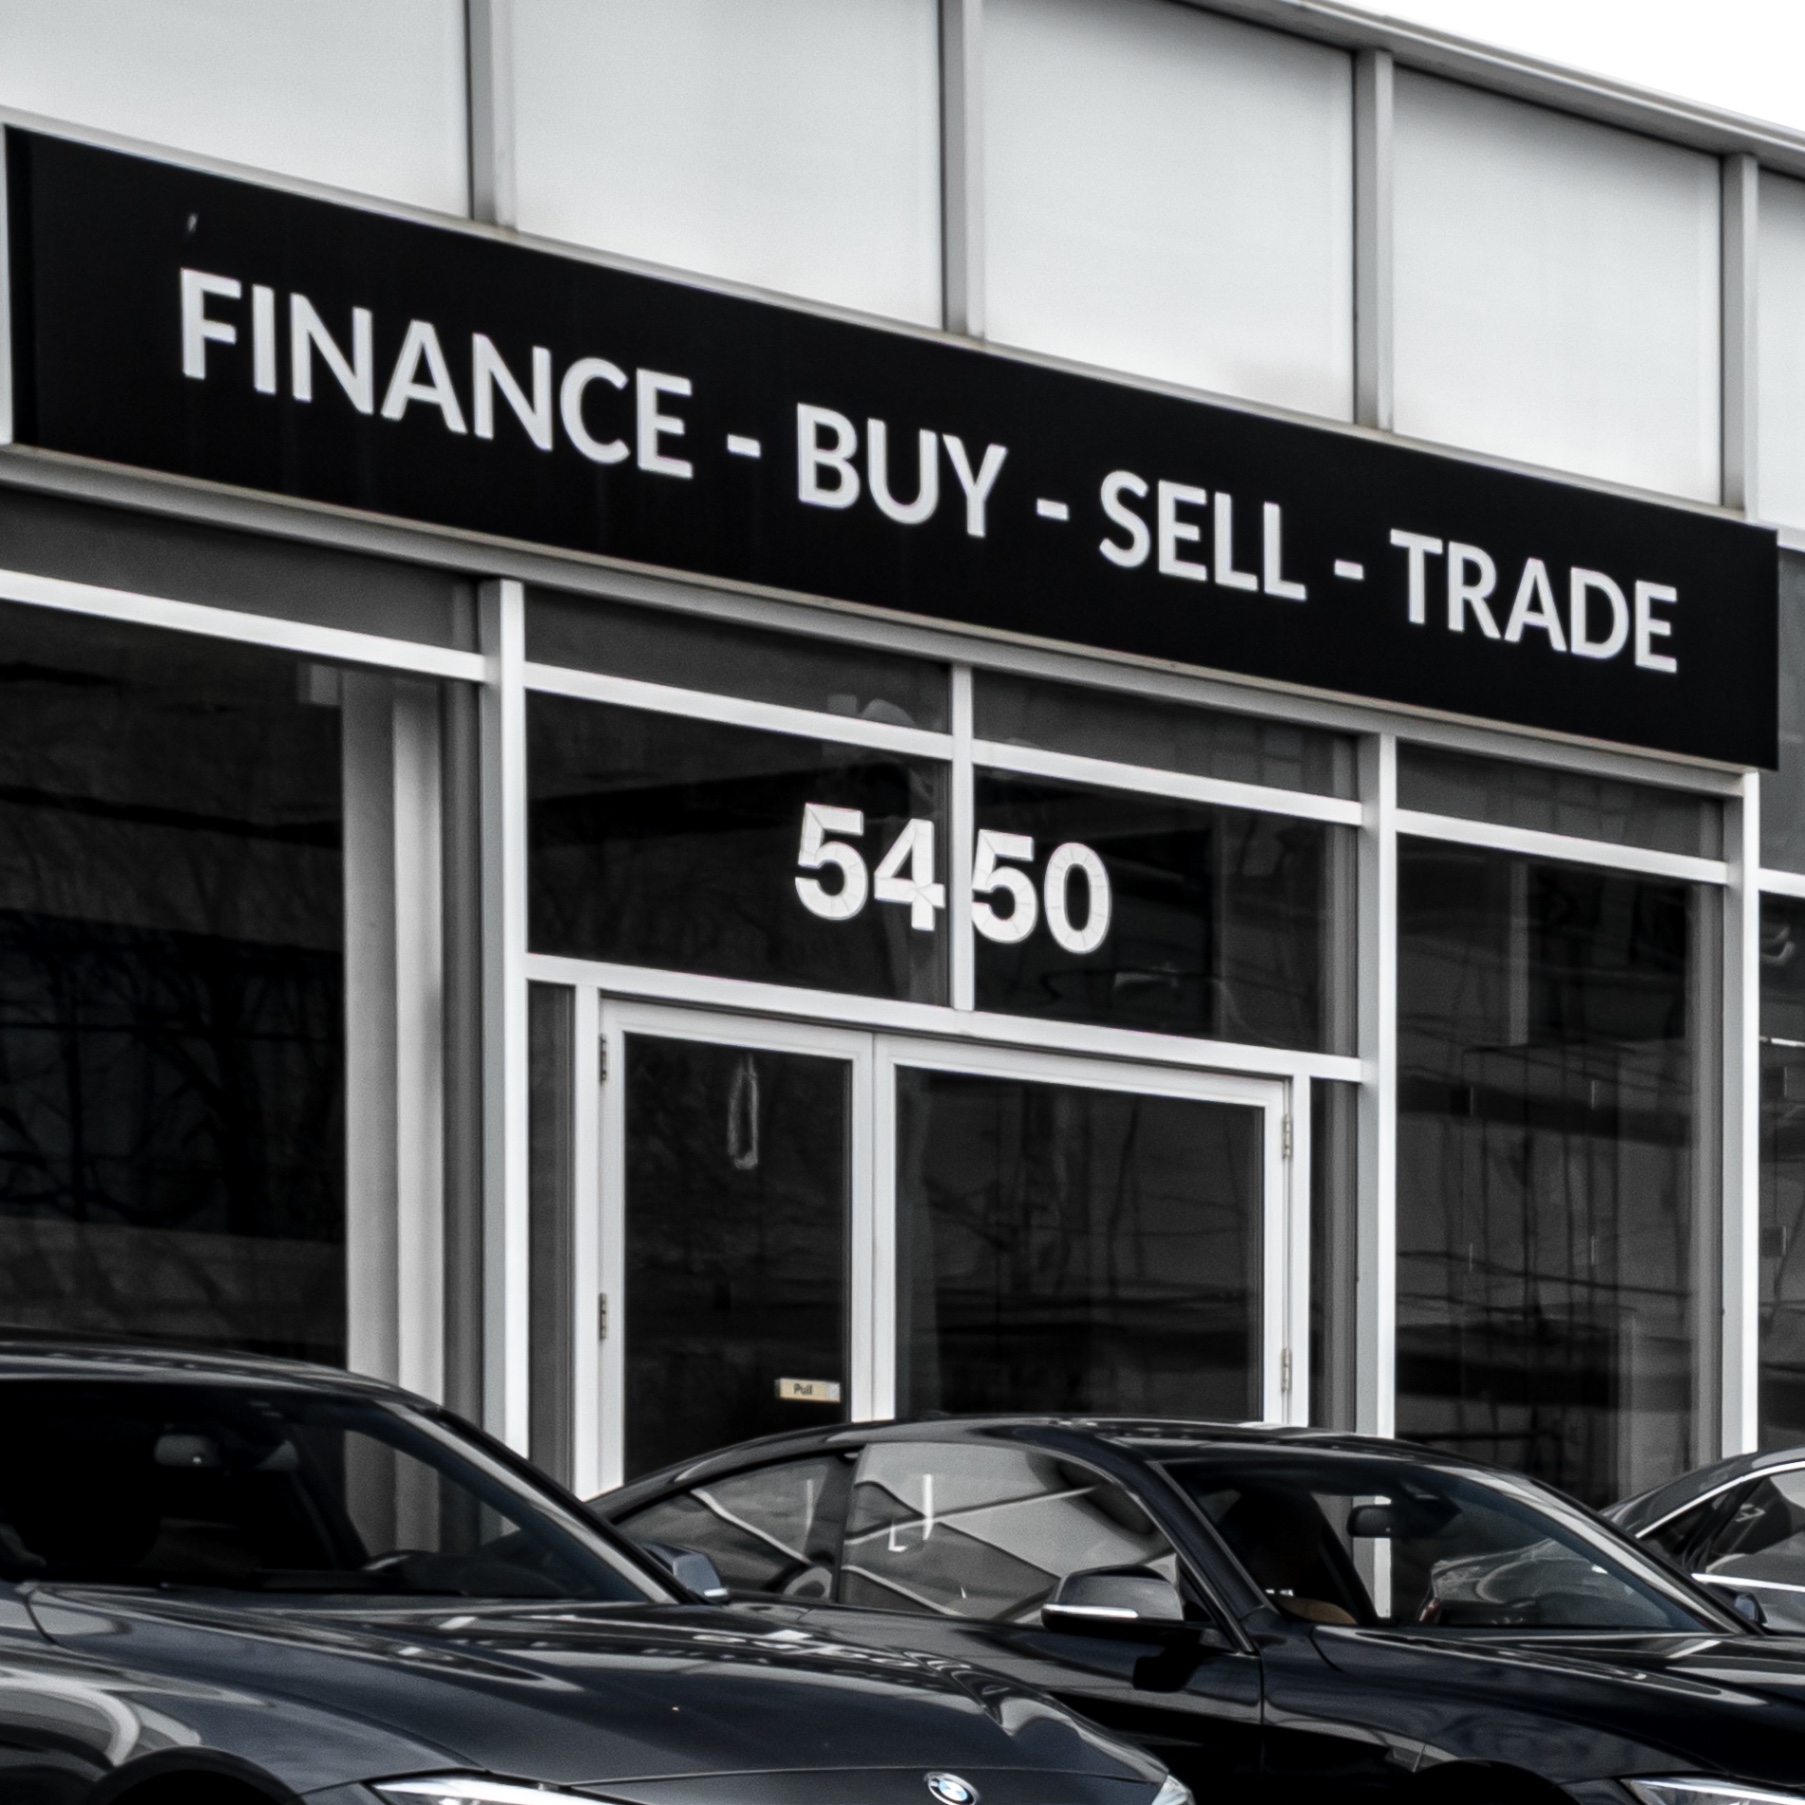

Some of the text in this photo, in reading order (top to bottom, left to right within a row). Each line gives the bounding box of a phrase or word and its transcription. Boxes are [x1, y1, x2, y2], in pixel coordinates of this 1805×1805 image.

[178, 266, 696, 481] FINANCE
[796, 402, 1008, 538] BUY
[1099, 470, 1307, 601] SELL
[1389, 528, 1679, 674] TRADE
[793, 802, 1113, 955] 5450
